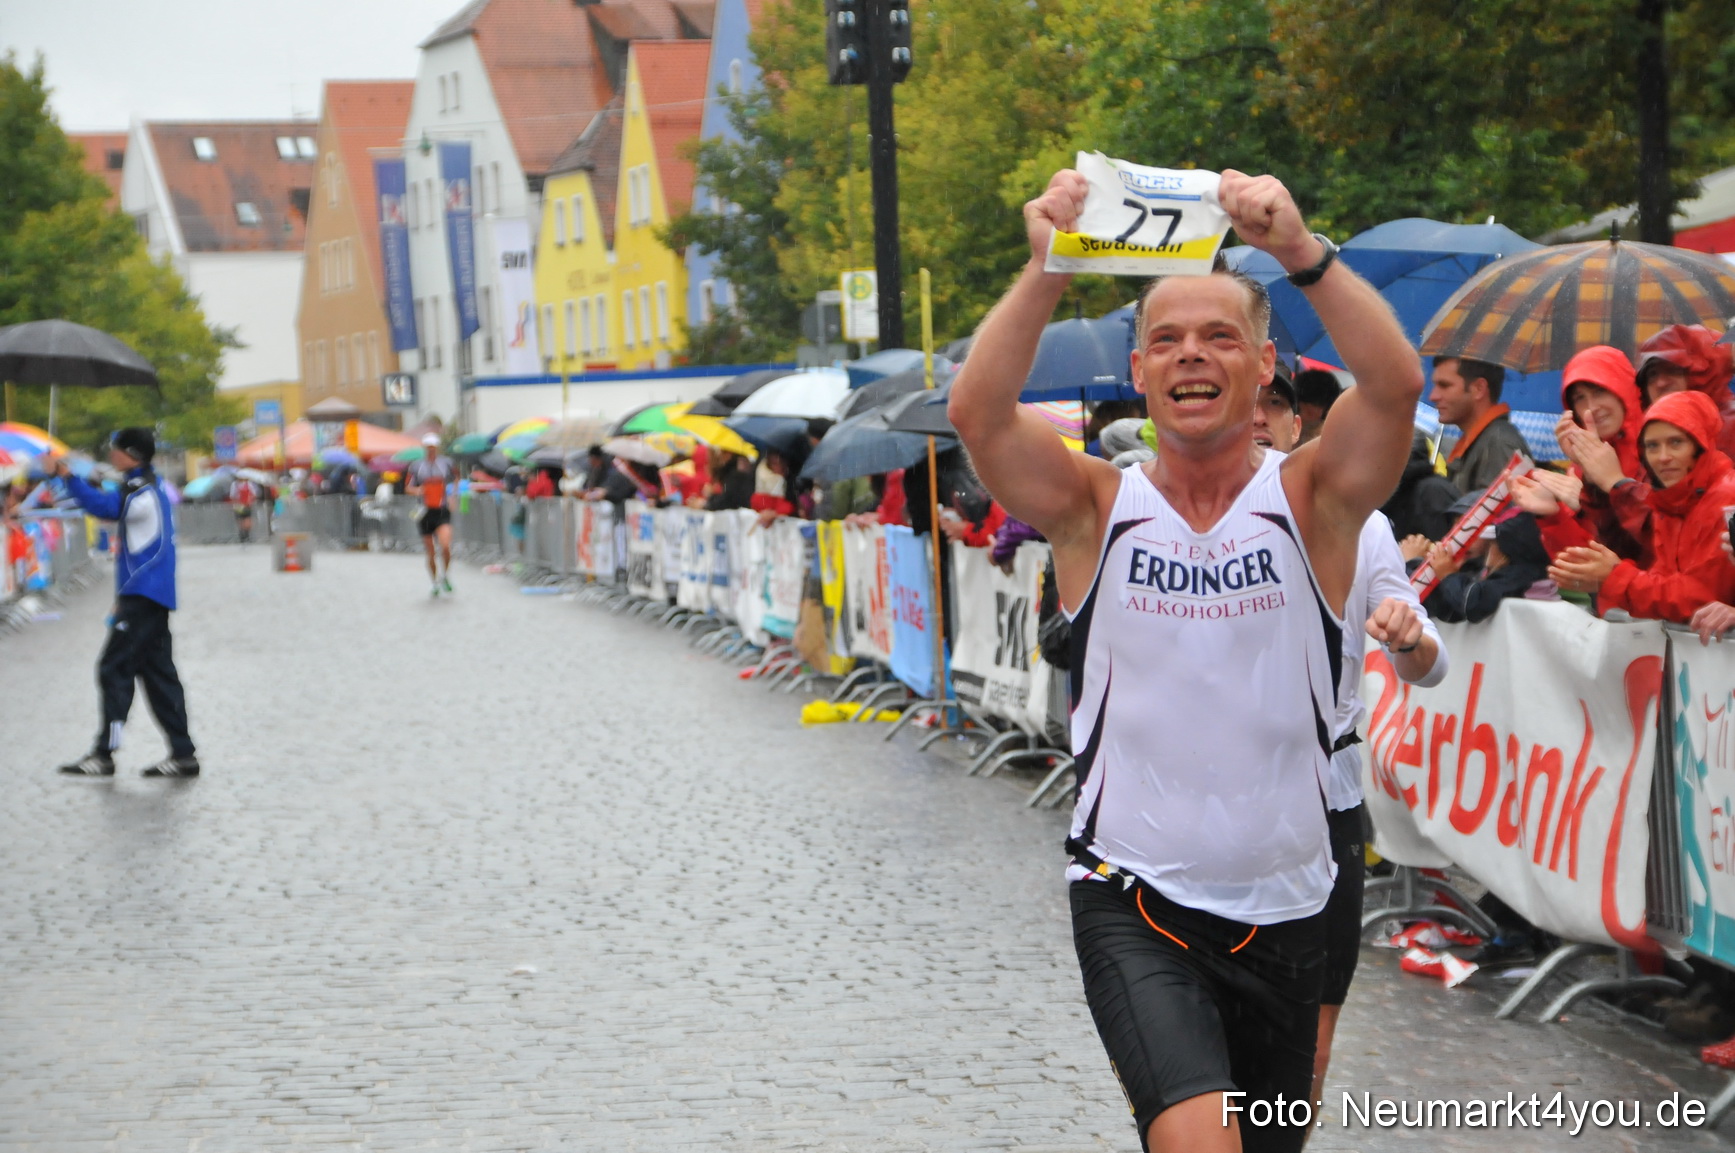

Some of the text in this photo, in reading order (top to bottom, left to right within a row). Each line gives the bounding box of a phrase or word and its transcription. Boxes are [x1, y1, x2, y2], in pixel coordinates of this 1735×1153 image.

[1118, 170, 1184, 190] BOCK
[1115, 198, 1182, 247] 27
[1171, 539, 1236, 562] TEAM
[1127, 546, 1282, 596] ERDINGER
[1126, 591, 1285, 620] ALKOHOLFREI
